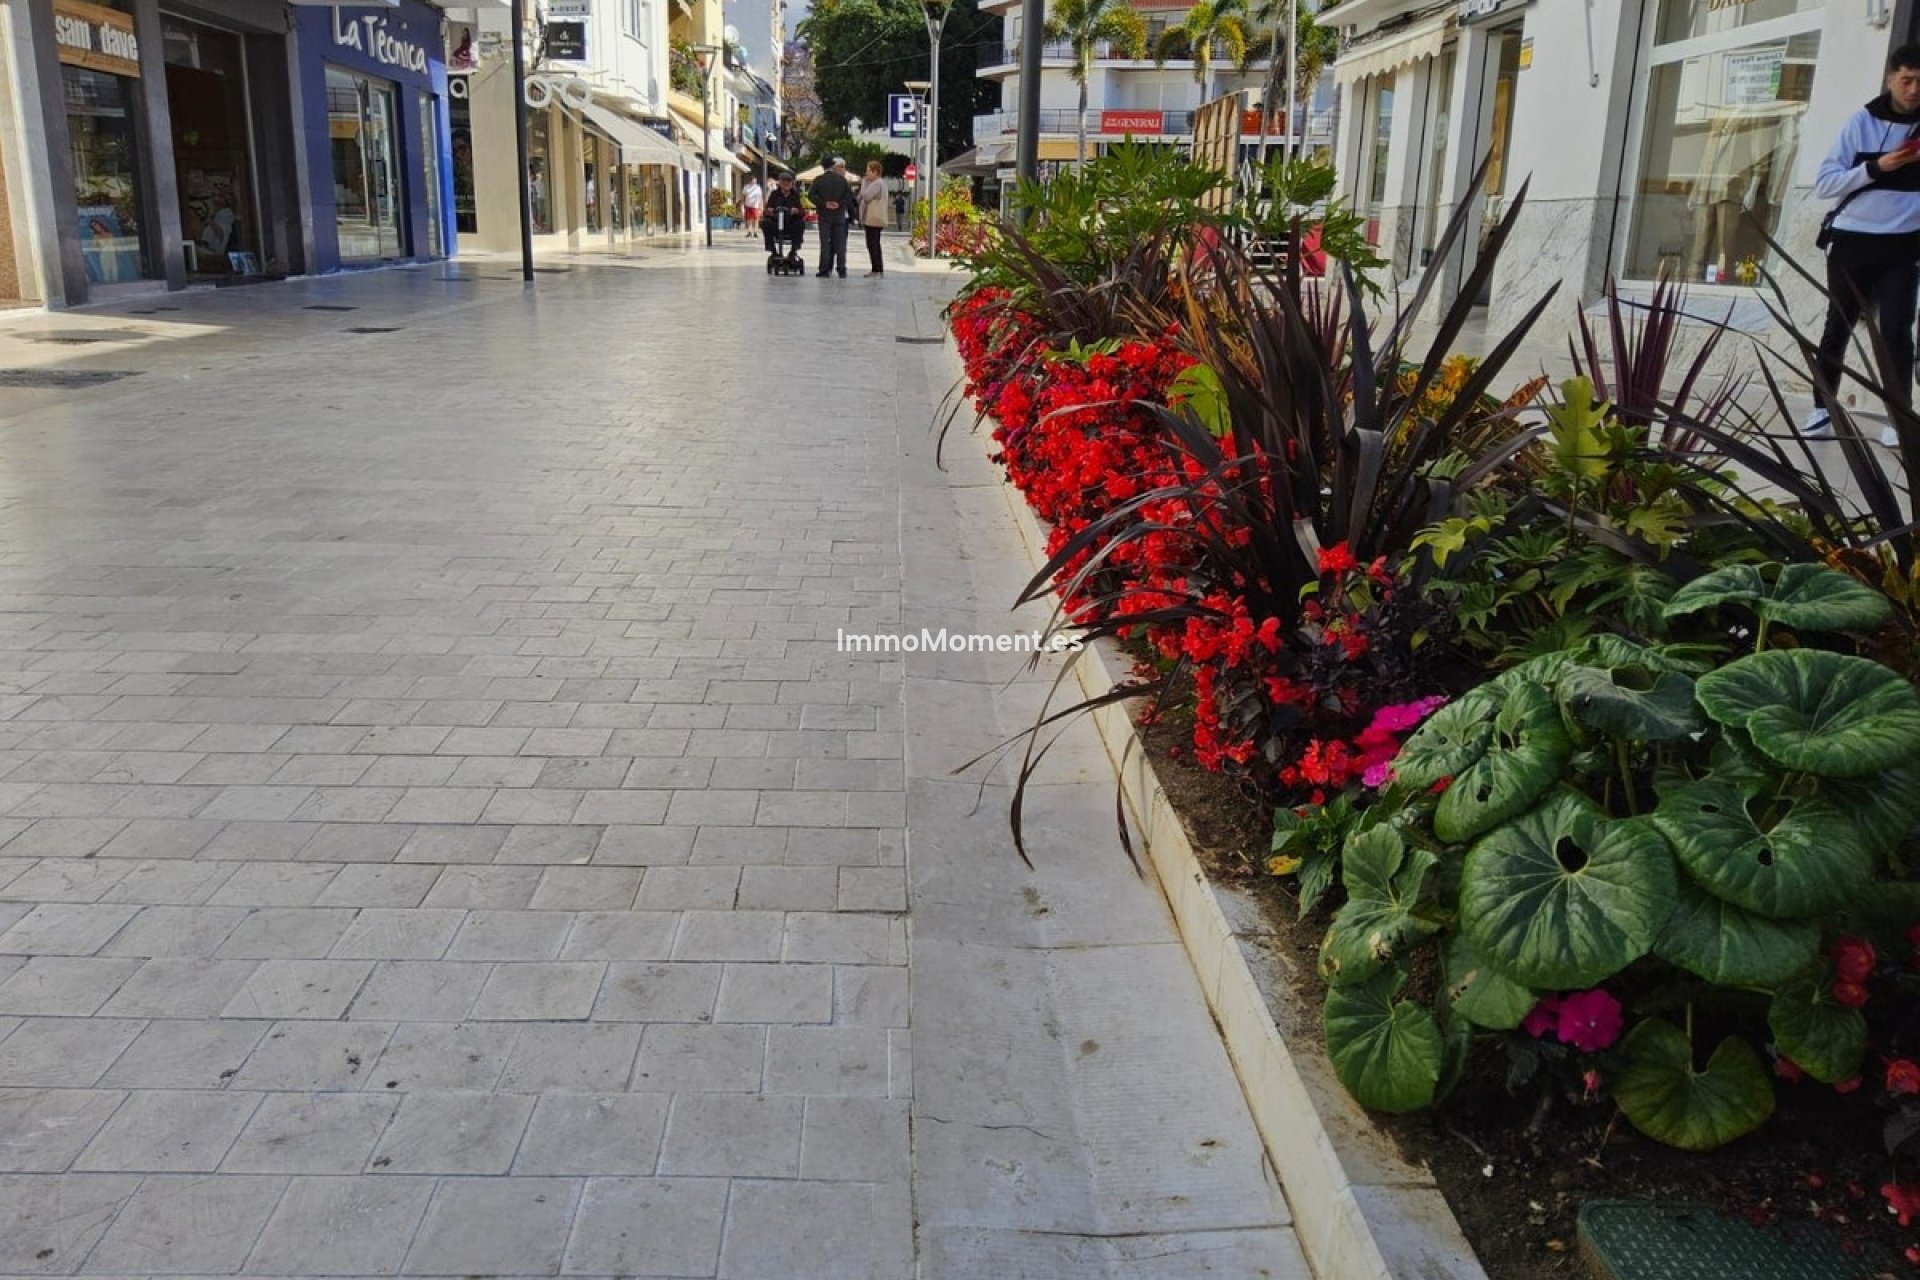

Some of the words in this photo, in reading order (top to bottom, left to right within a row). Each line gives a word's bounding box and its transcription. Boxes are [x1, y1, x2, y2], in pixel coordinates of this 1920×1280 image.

[54, 15, 92, 50] sam
[99, 21, 139, 60] dave
[332, 5, 363, 51] La
[361, 15, 428, 75] Técnica
[897, 97, 916, 122] P
[1119, 117, 1161, 129] GENERALI
